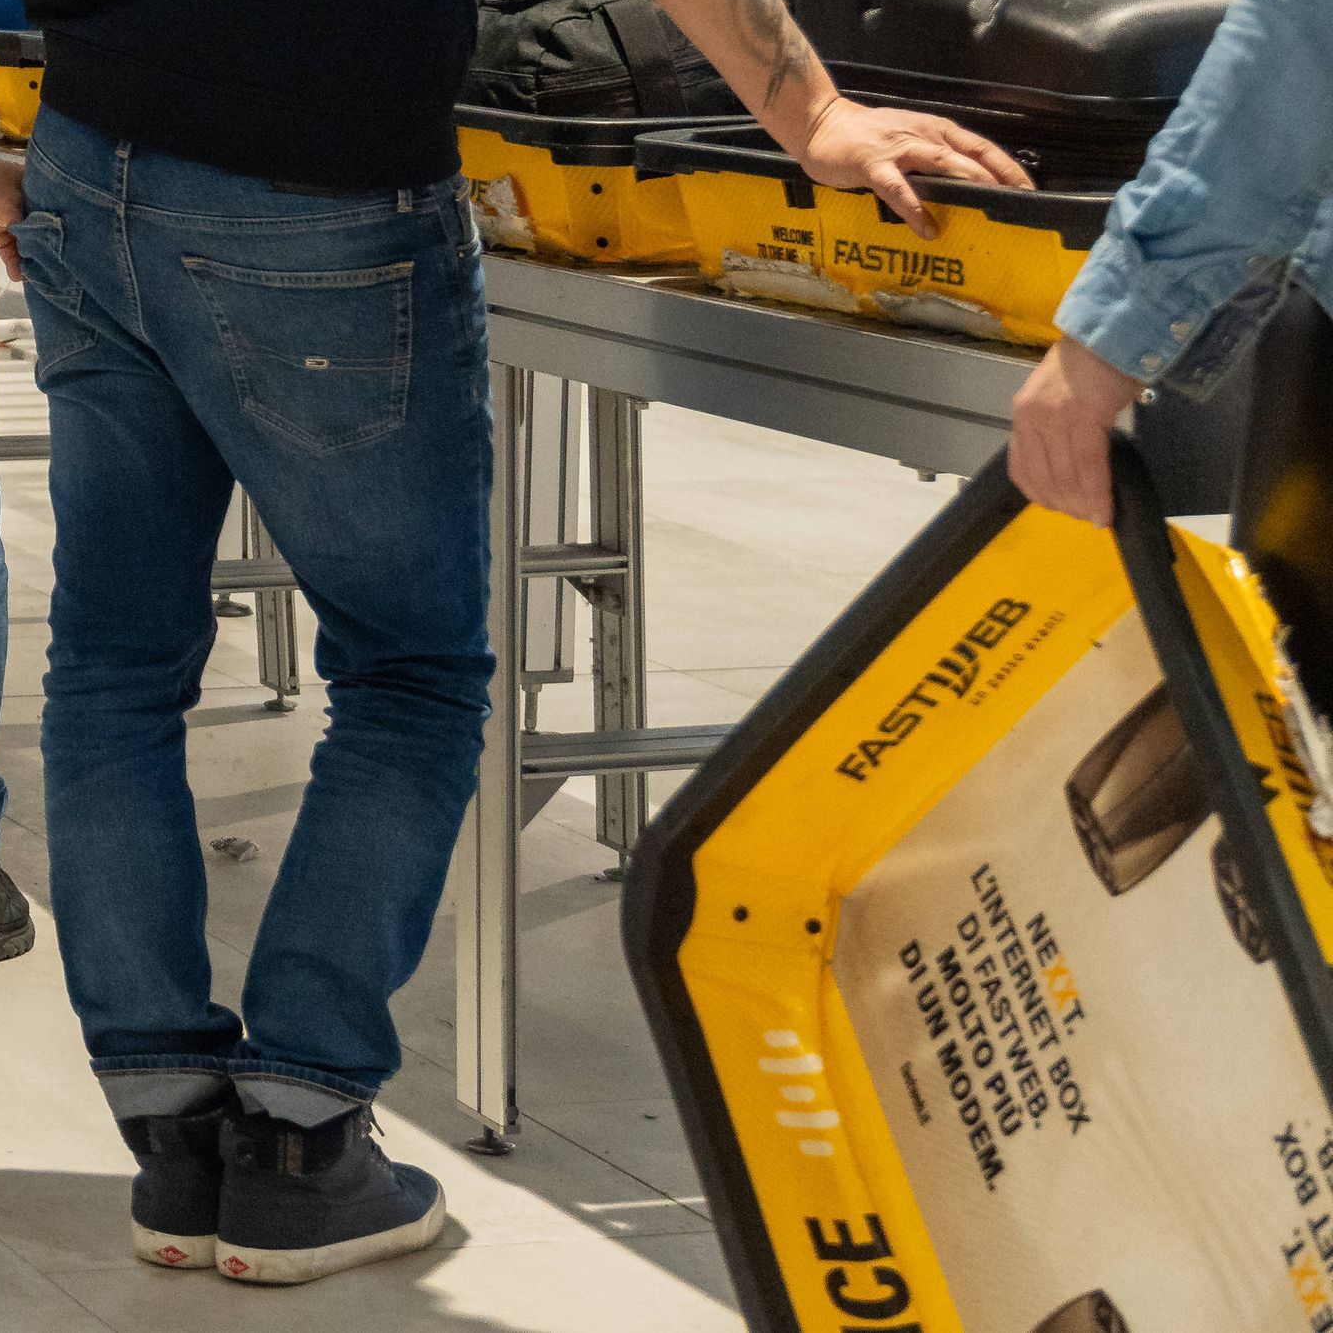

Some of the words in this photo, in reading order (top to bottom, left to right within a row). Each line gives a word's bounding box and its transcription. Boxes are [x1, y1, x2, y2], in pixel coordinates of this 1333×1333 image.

[771, 225, 814, 246] WELCOME
[834, 238, 965, 287] FASTWEB
[835, 597, 1030, 782] FASTWEB
[898, 938, 928, 985] DI
[915, 980, 951, 1041] UN
[936, 1039, 1006, 1194] MODEM.
[935, 944, 995, 1069] MOLTO
[984, 1071, 1024, 1137] PIÙ
[956, 912, 985, 955] DI
[973, 954, 1049, 1130] FASTWEB.
[969, 862, 1061, 1051] L'INTERNET
[1047, 1055, 1092, 1136] BOX
[1271, 1120, 1320, 1207] BOX
